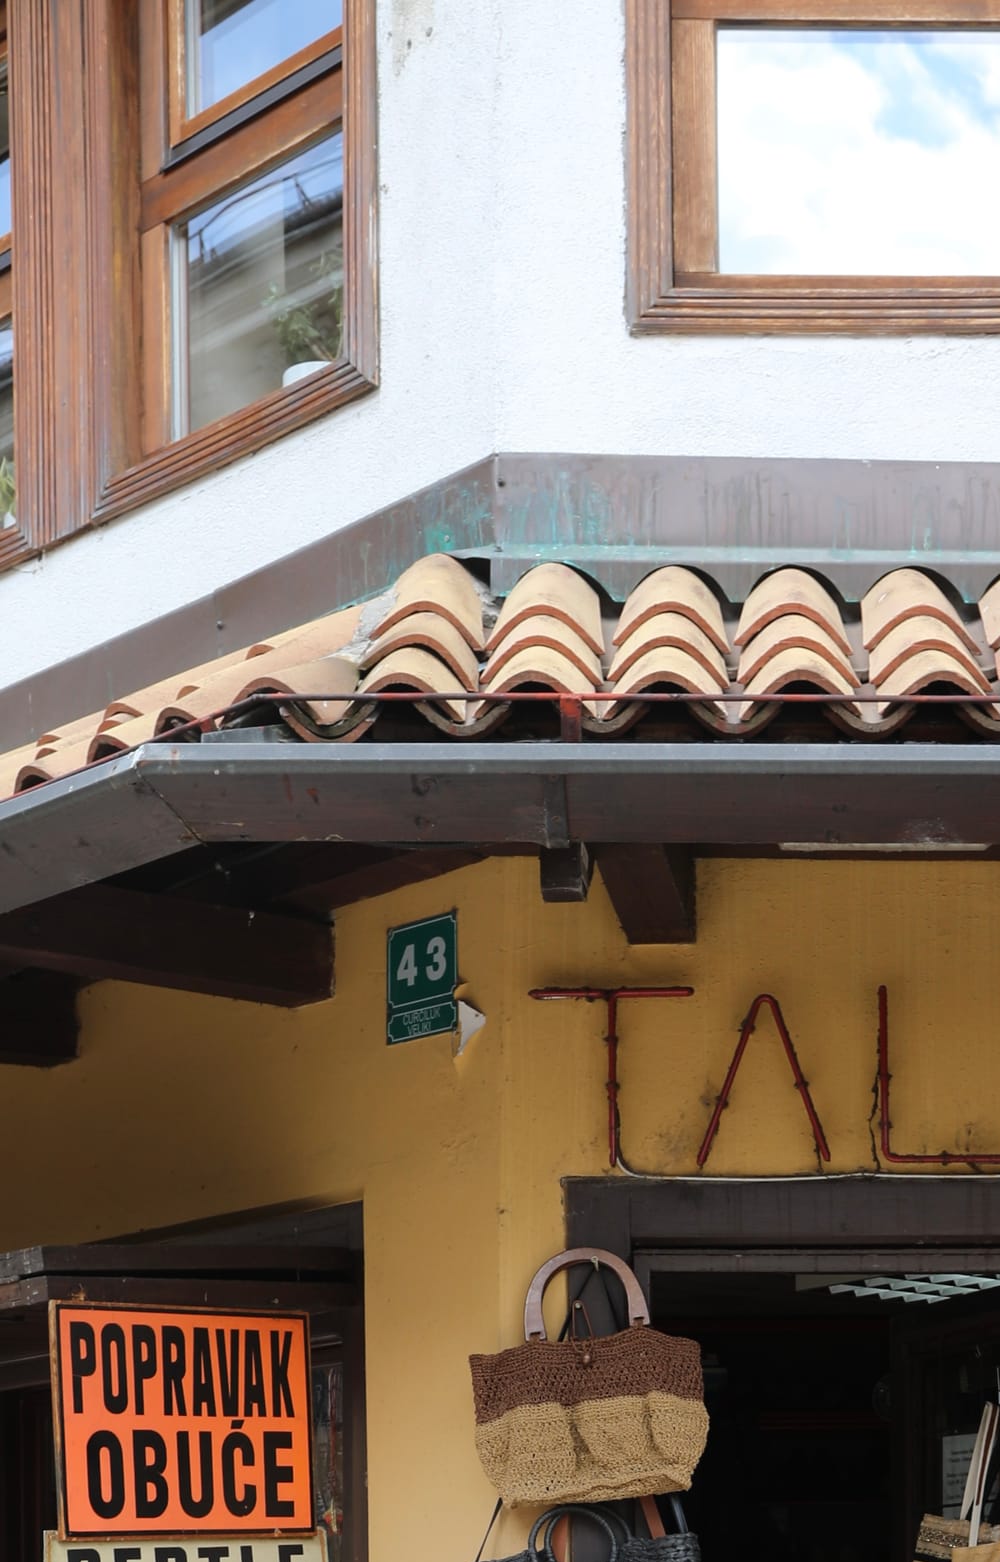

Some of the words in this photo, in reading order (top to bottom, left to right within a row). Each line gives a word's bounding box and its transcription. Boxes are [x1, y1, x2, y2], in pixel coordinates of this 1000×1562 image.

[396, 936, 447, 986] 43
[69, 1320, 295, 1418] POPRAVAK
[86, 1418, 295, 1519] OBUĆE
